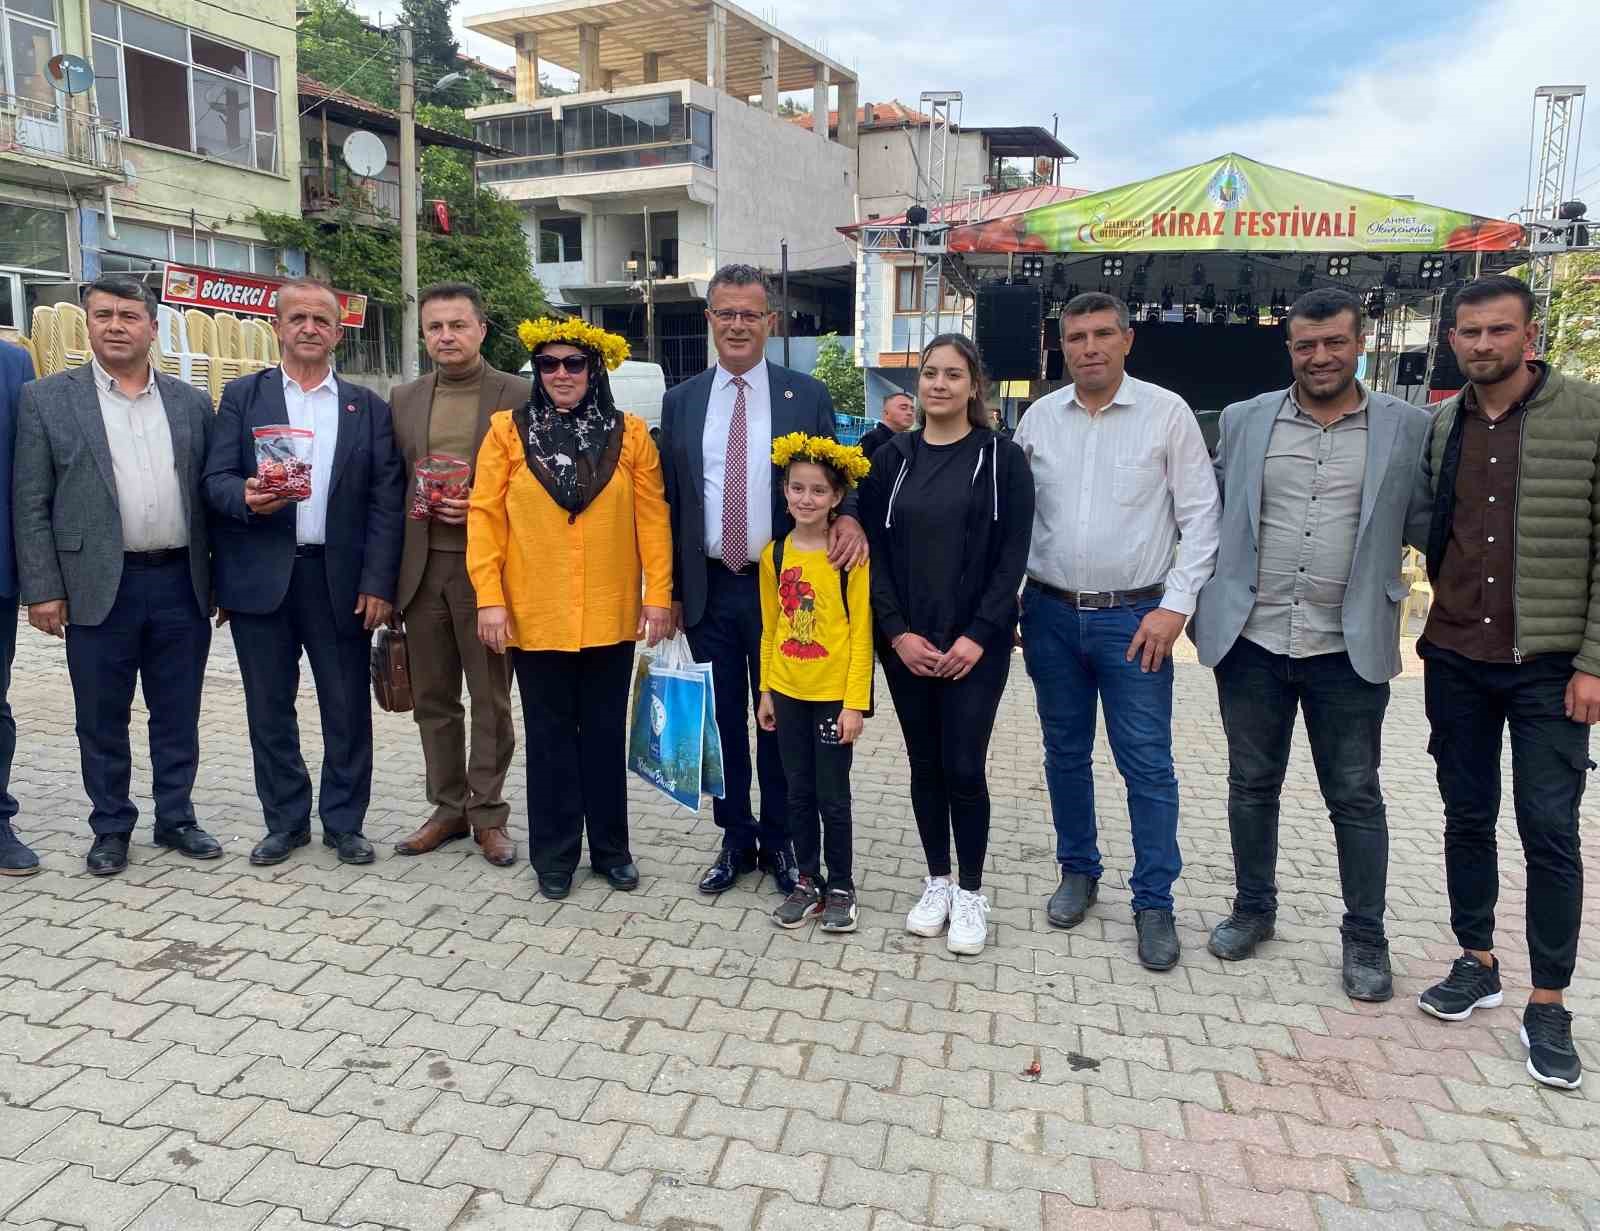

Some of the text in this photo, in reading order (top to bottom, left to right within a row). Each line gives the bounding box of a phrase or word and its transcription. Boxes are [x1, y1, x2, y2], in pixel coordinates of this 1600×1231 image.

[1151, 205, 1356, 237] KİRAZ FESTİVALİ
[1384, 216, 1416, 224] AHMET
